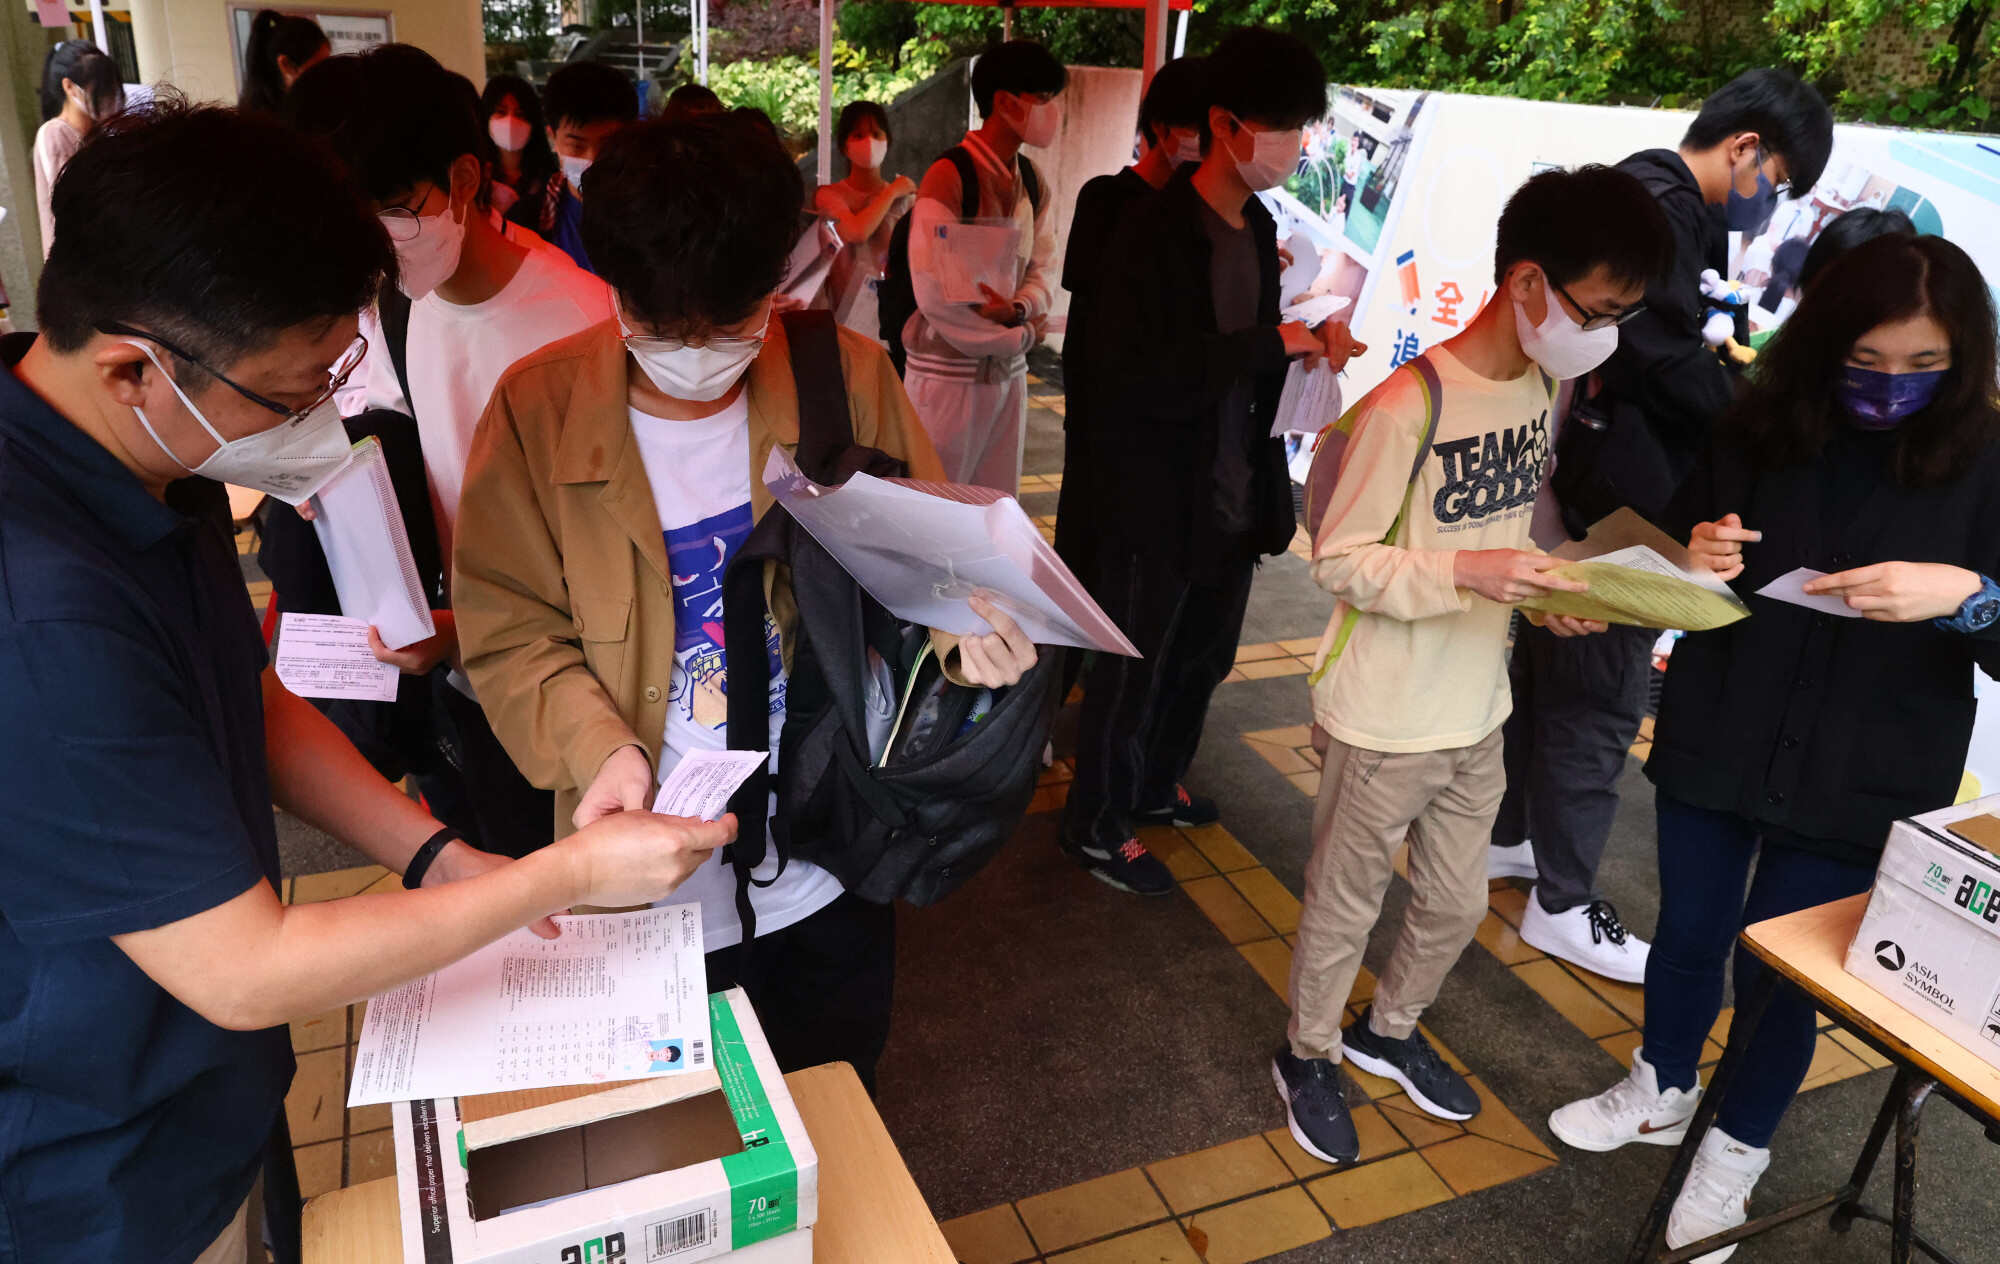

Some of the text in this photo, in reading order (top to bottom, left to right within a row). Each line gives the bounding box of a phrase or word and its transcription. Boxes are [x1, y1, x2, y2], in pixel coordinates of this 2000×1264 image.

[1432, 424, 1527, 486] TEAM
[1437, 524, 1460, 534] SUCCESS
[1927, 862, 1943, 879] 70
[1954, 874, 2000, 924] ace
[1910, 961, 1939, 985] ASIA
[1905, 971, 1956, 1010] SYMBOL
[420, 1105, 429, 1130] excellent
[423, 1131, 432, 1154] delivers
[424, 1155, 433, 1169] that
[428, 1169, 436, 1187] paper
[428, 1187, 437, 1205] office
[748, 1196, 767, 1214] 70
[431, 1205, 441, 1234] Superior
